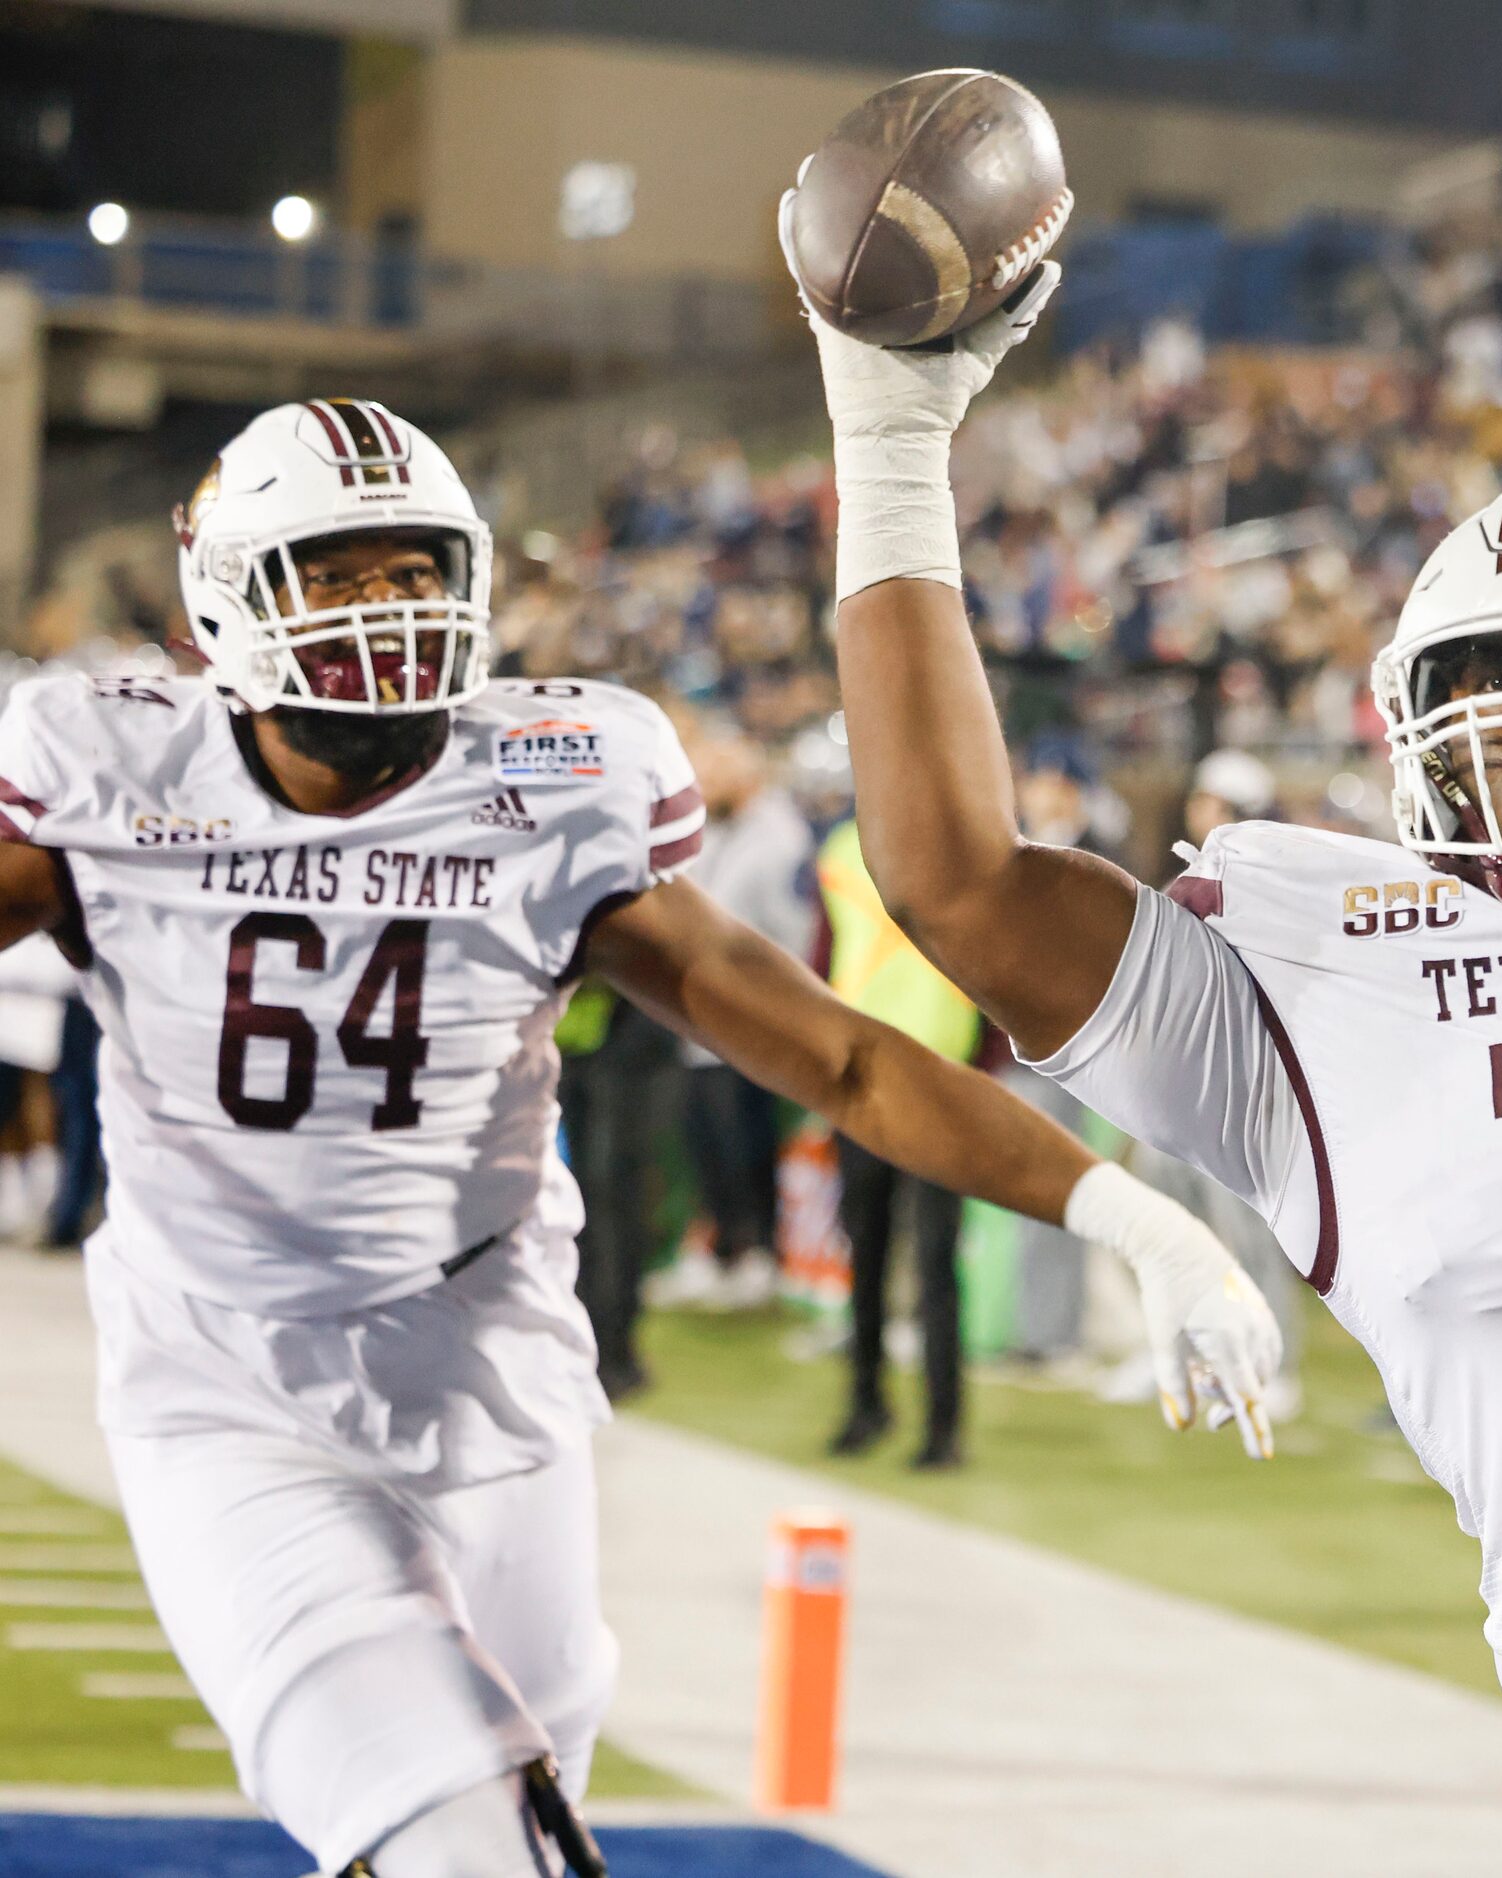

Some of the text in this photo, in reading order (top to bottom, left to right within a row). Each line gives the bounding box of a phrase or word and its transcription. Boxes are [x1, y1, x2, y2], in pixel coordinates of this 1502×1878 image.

[135, 816, 234, 846] SBC
[472, 808, 536, 832] adidas
[201, 845, 495, 907] TEXAS STATE
[1342, 877, 1464, 937] SBC
[217, 911, 431, 1132] 64
